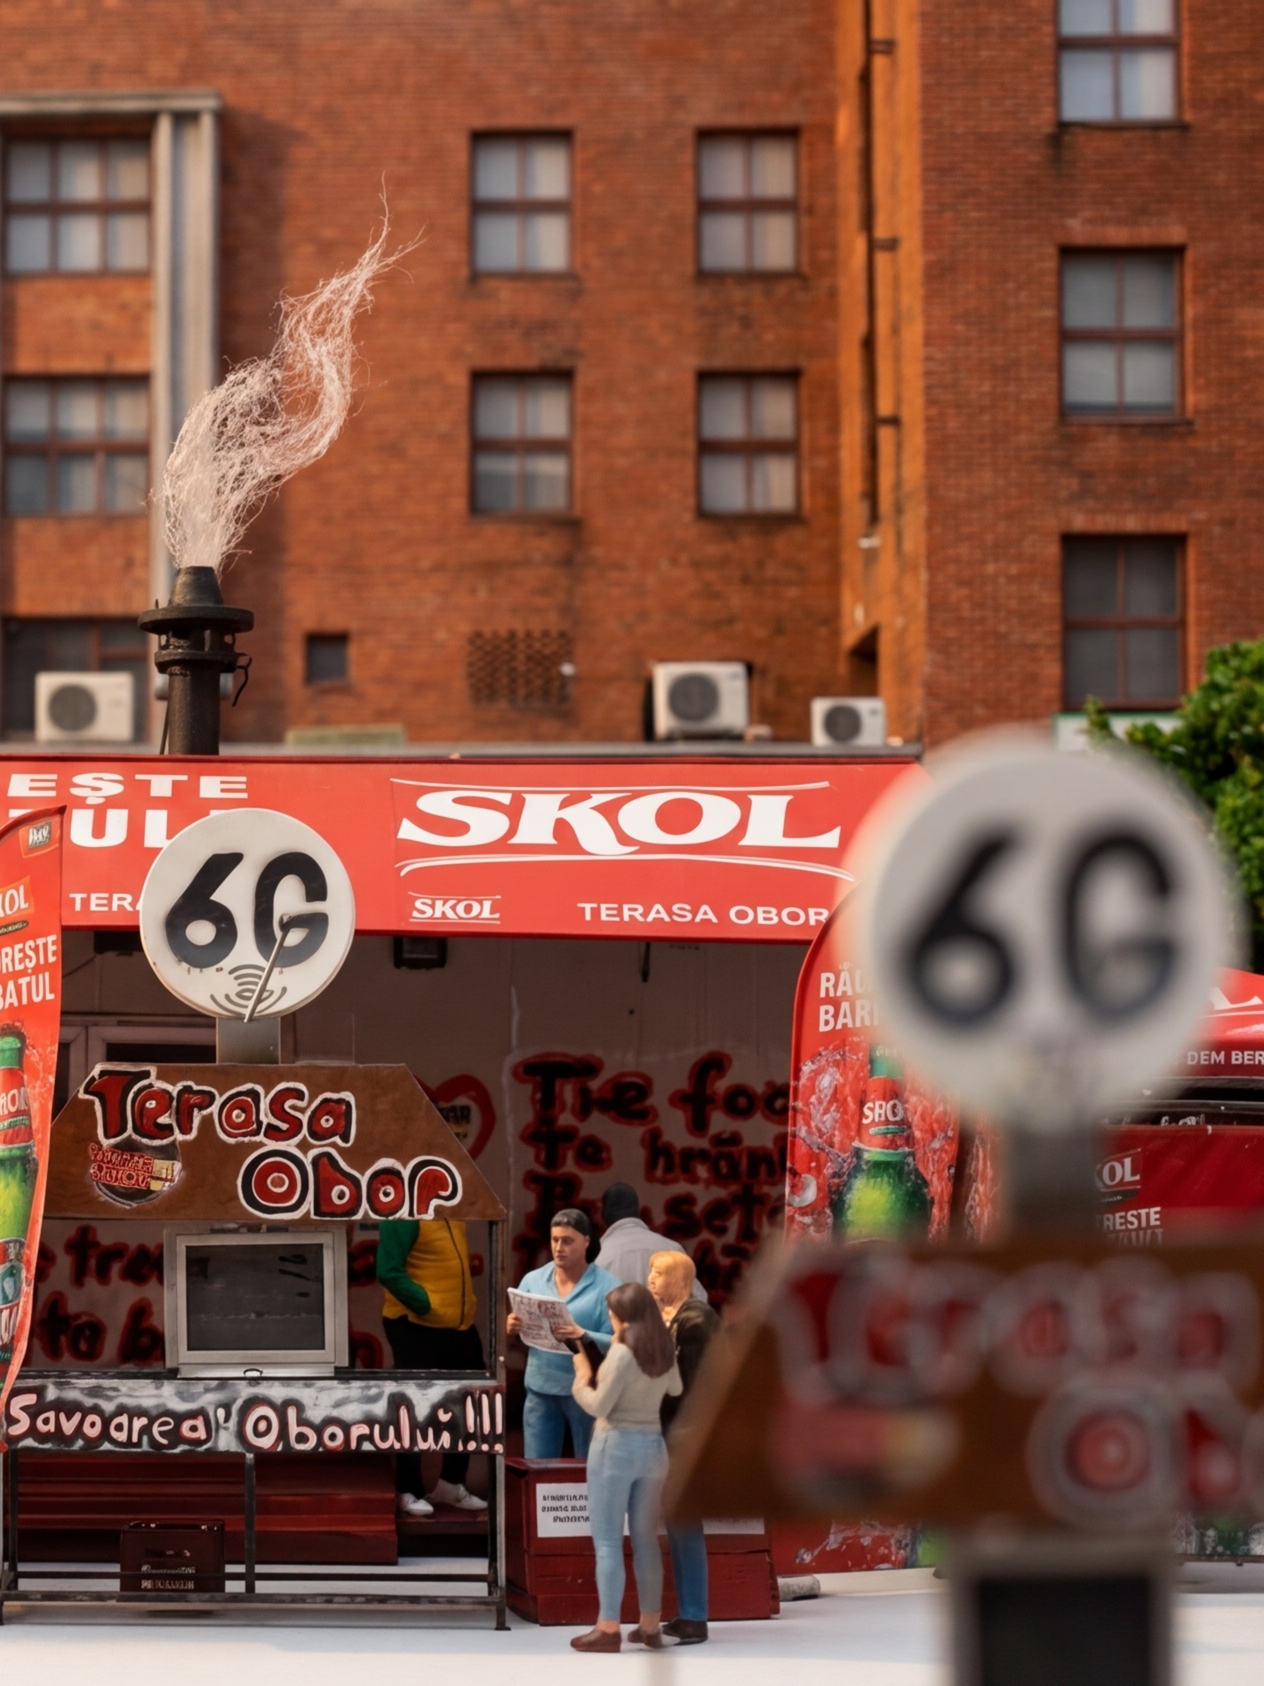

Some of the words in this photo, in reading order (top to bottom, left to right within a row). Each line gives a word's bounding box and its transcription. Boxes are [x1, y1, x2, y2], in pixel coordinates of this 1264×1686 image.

[396, 790, 841, 855] SKOL
[69, 892, 142, 912] TER
[165, 851, 329, 969] 6G
[411, 898, 501, 920] SKOL
[577, 902, 718, 923] TERASA
[728, 905, 829, 926] OBOR
[79, 1062, 357, 1147] Terasa
[237, 1145, 464, 1221] Obor
[1100, 1206, 1161, 1232] RESTE
